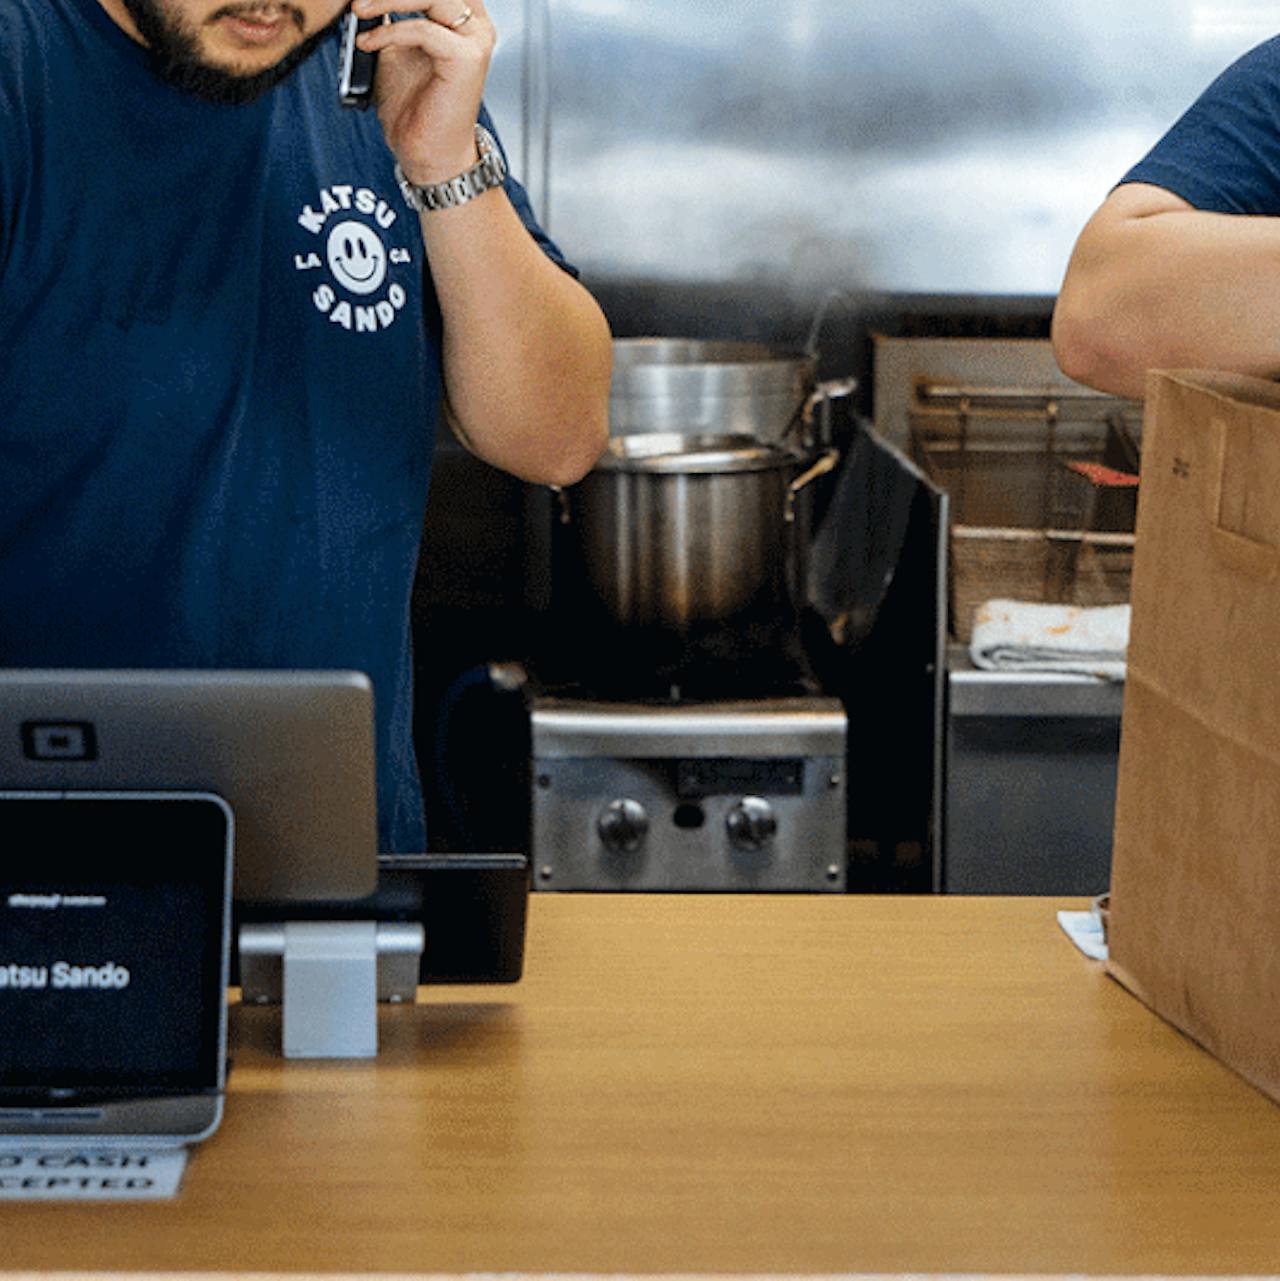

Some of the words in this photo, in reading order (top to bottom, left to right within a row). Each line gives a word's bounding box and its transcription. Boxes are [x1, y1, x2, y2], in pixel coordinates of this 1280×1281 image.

[297, 185, 397, 234] KATSU
[294, 253, 322, 269] LA
[389, 247, 411, 264] CA
[312, 283, 407, 333] SANDO
[51, 960, 130, 989] Sando
[37, 1154, 148, 1168] CASH
